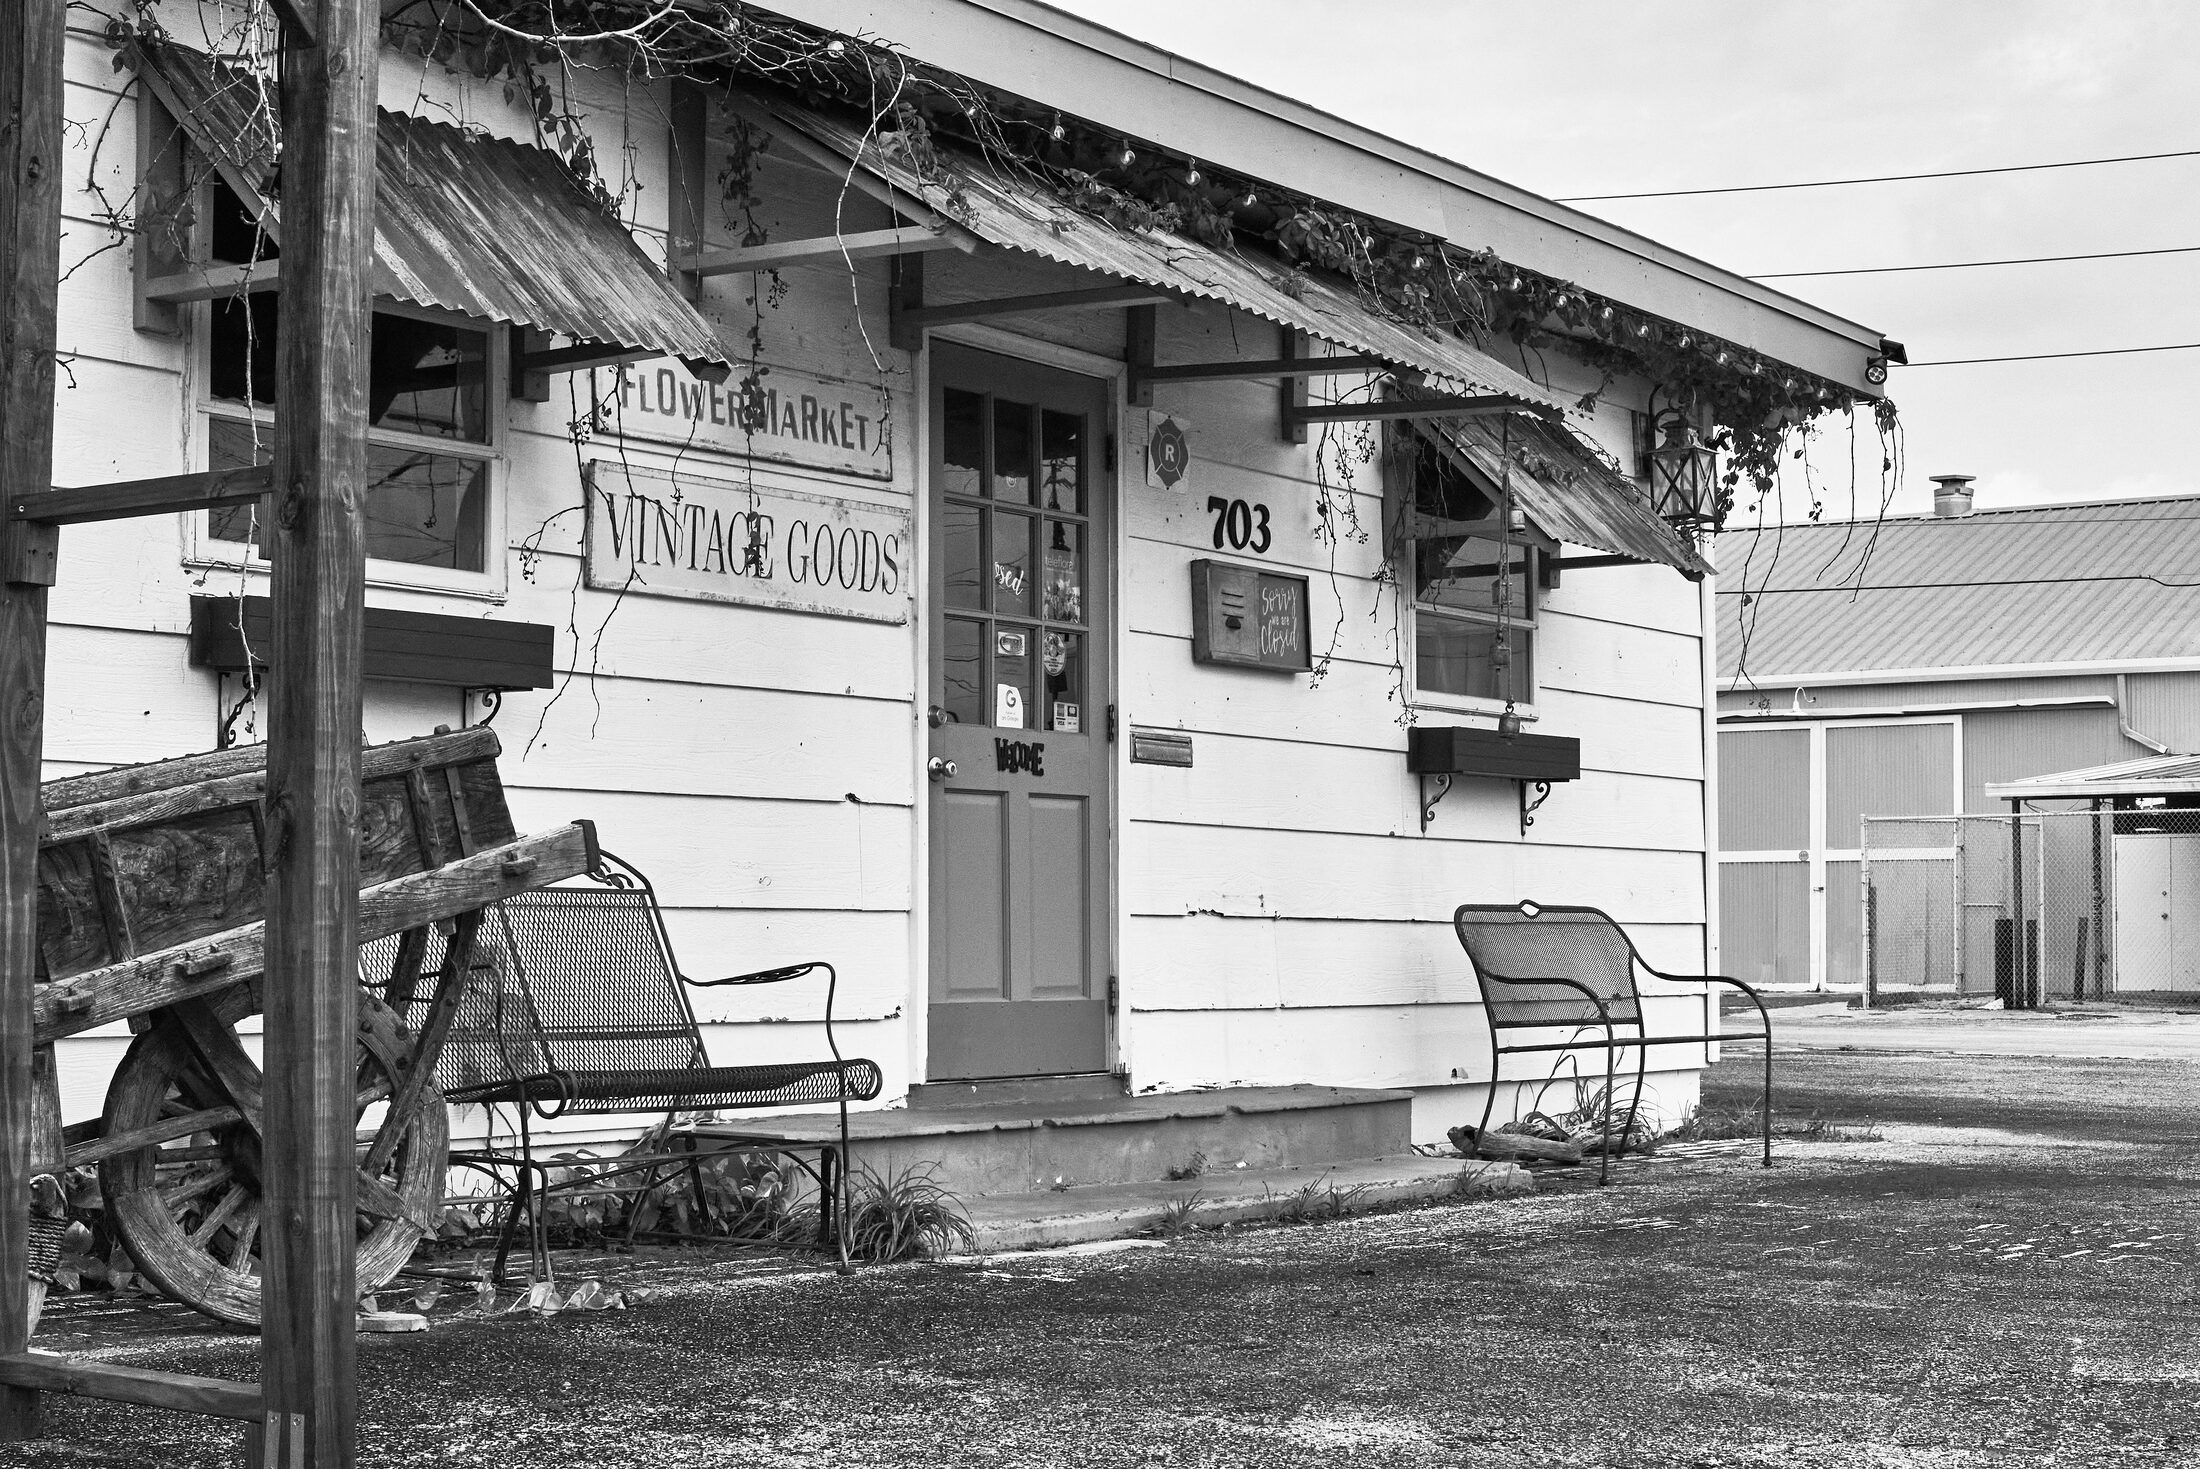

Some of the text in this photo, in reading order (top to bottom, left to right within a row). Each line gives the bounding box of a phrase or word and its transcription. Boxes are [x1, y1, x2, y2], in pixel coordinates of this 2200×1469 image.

[620, 363, 869, 451] FLOWER MARKET
[1165, 443, 1174, 463] R
[606, 492, 899, 595] VINTAGE GOODS
[1207, 495, 1272, 554] 703
[1261, 586, 1298, 619] Sorry
[1271, 615, 1290, 626] we are
[1260, 617, 1299, 657] Closed
